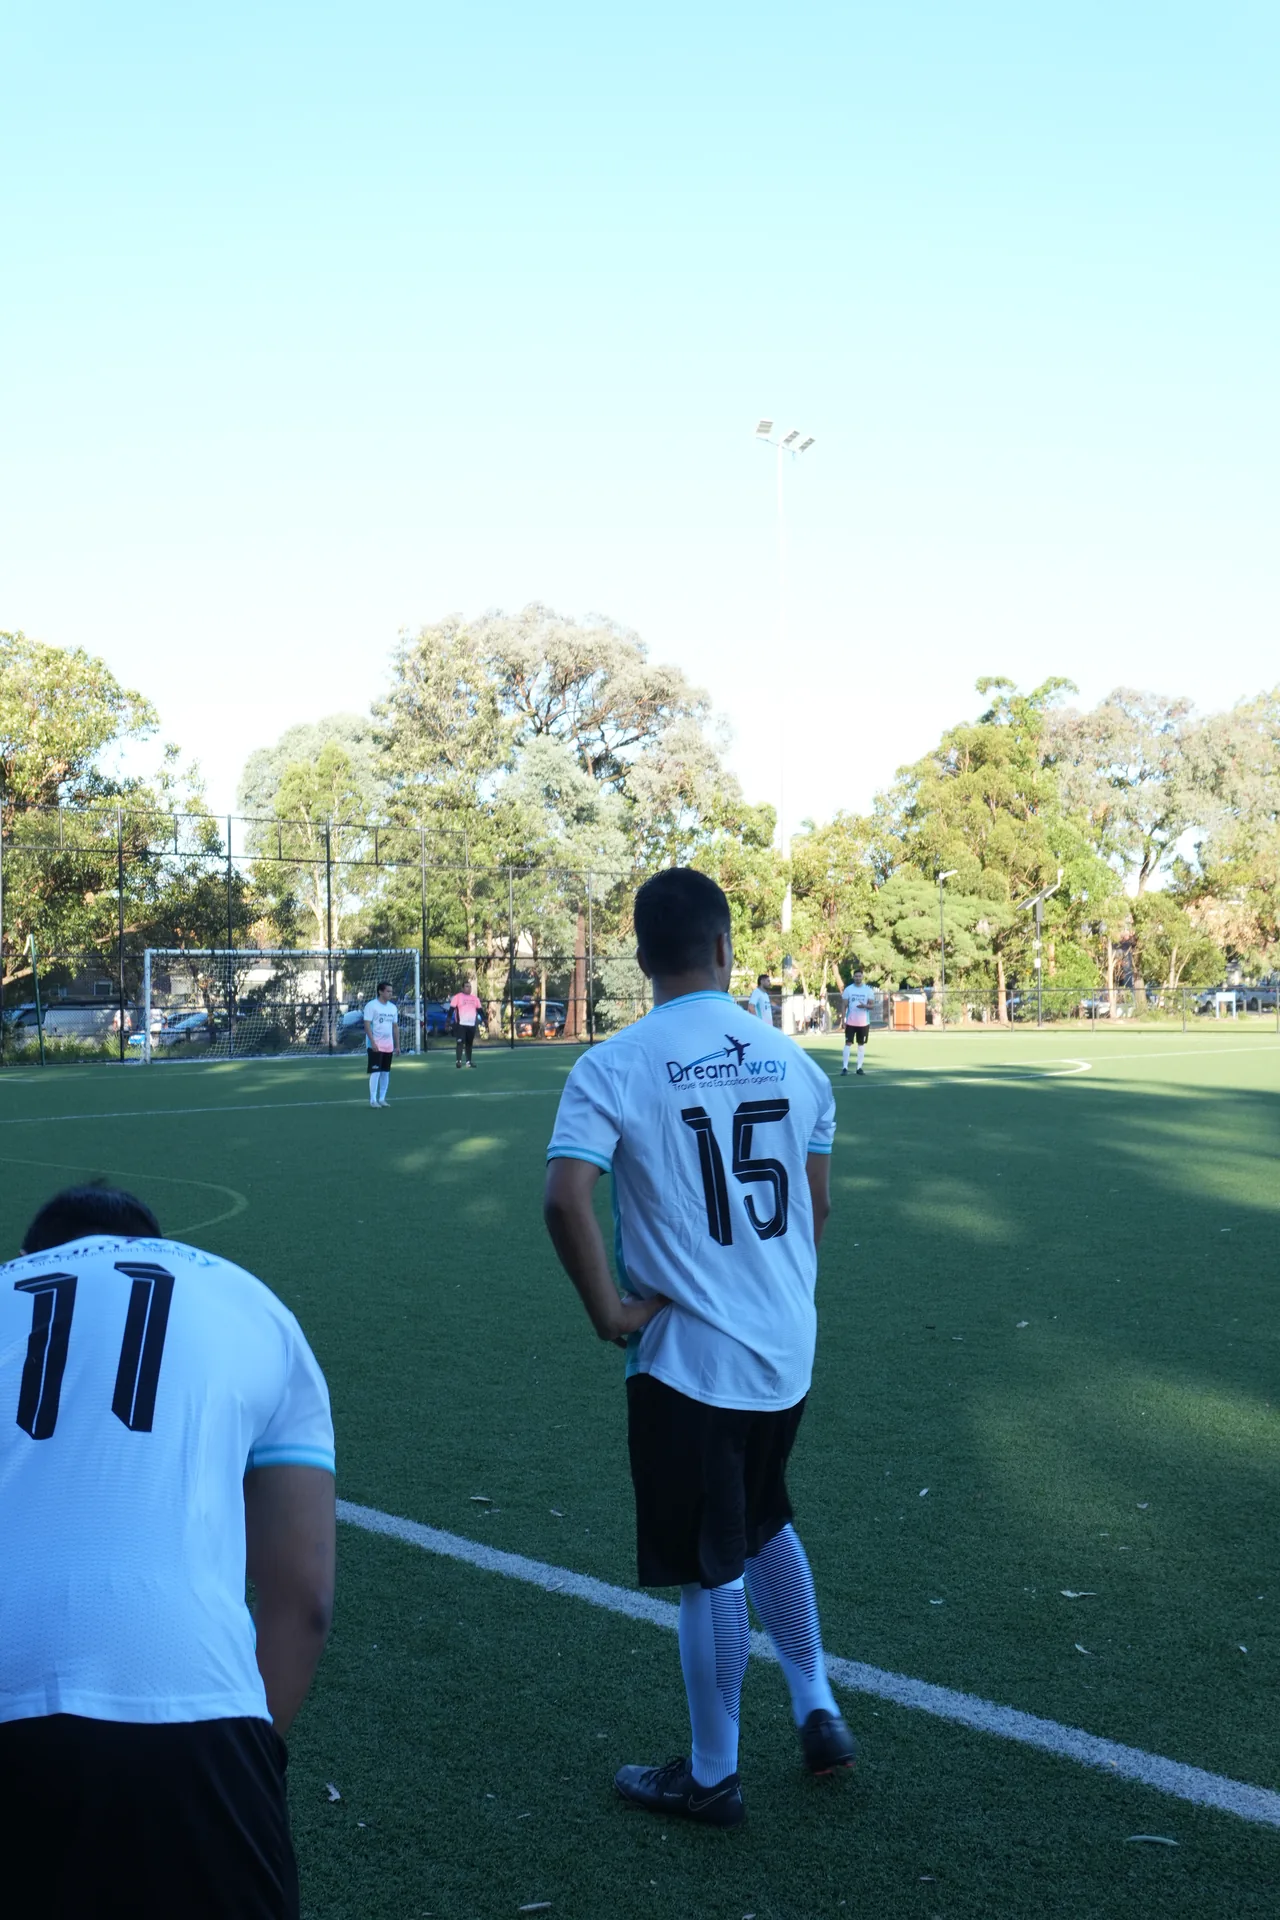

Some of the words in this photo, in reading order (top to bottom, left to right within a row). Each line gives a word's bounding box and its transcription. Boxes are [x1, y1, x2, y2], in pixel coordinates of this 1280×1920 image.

[666, 1061, 738, 1083] Dream
[745, 1059, 787, 1081] way
[681, 1098, 790, 1246] 15
[14, 1261, 175, 1440] 11
